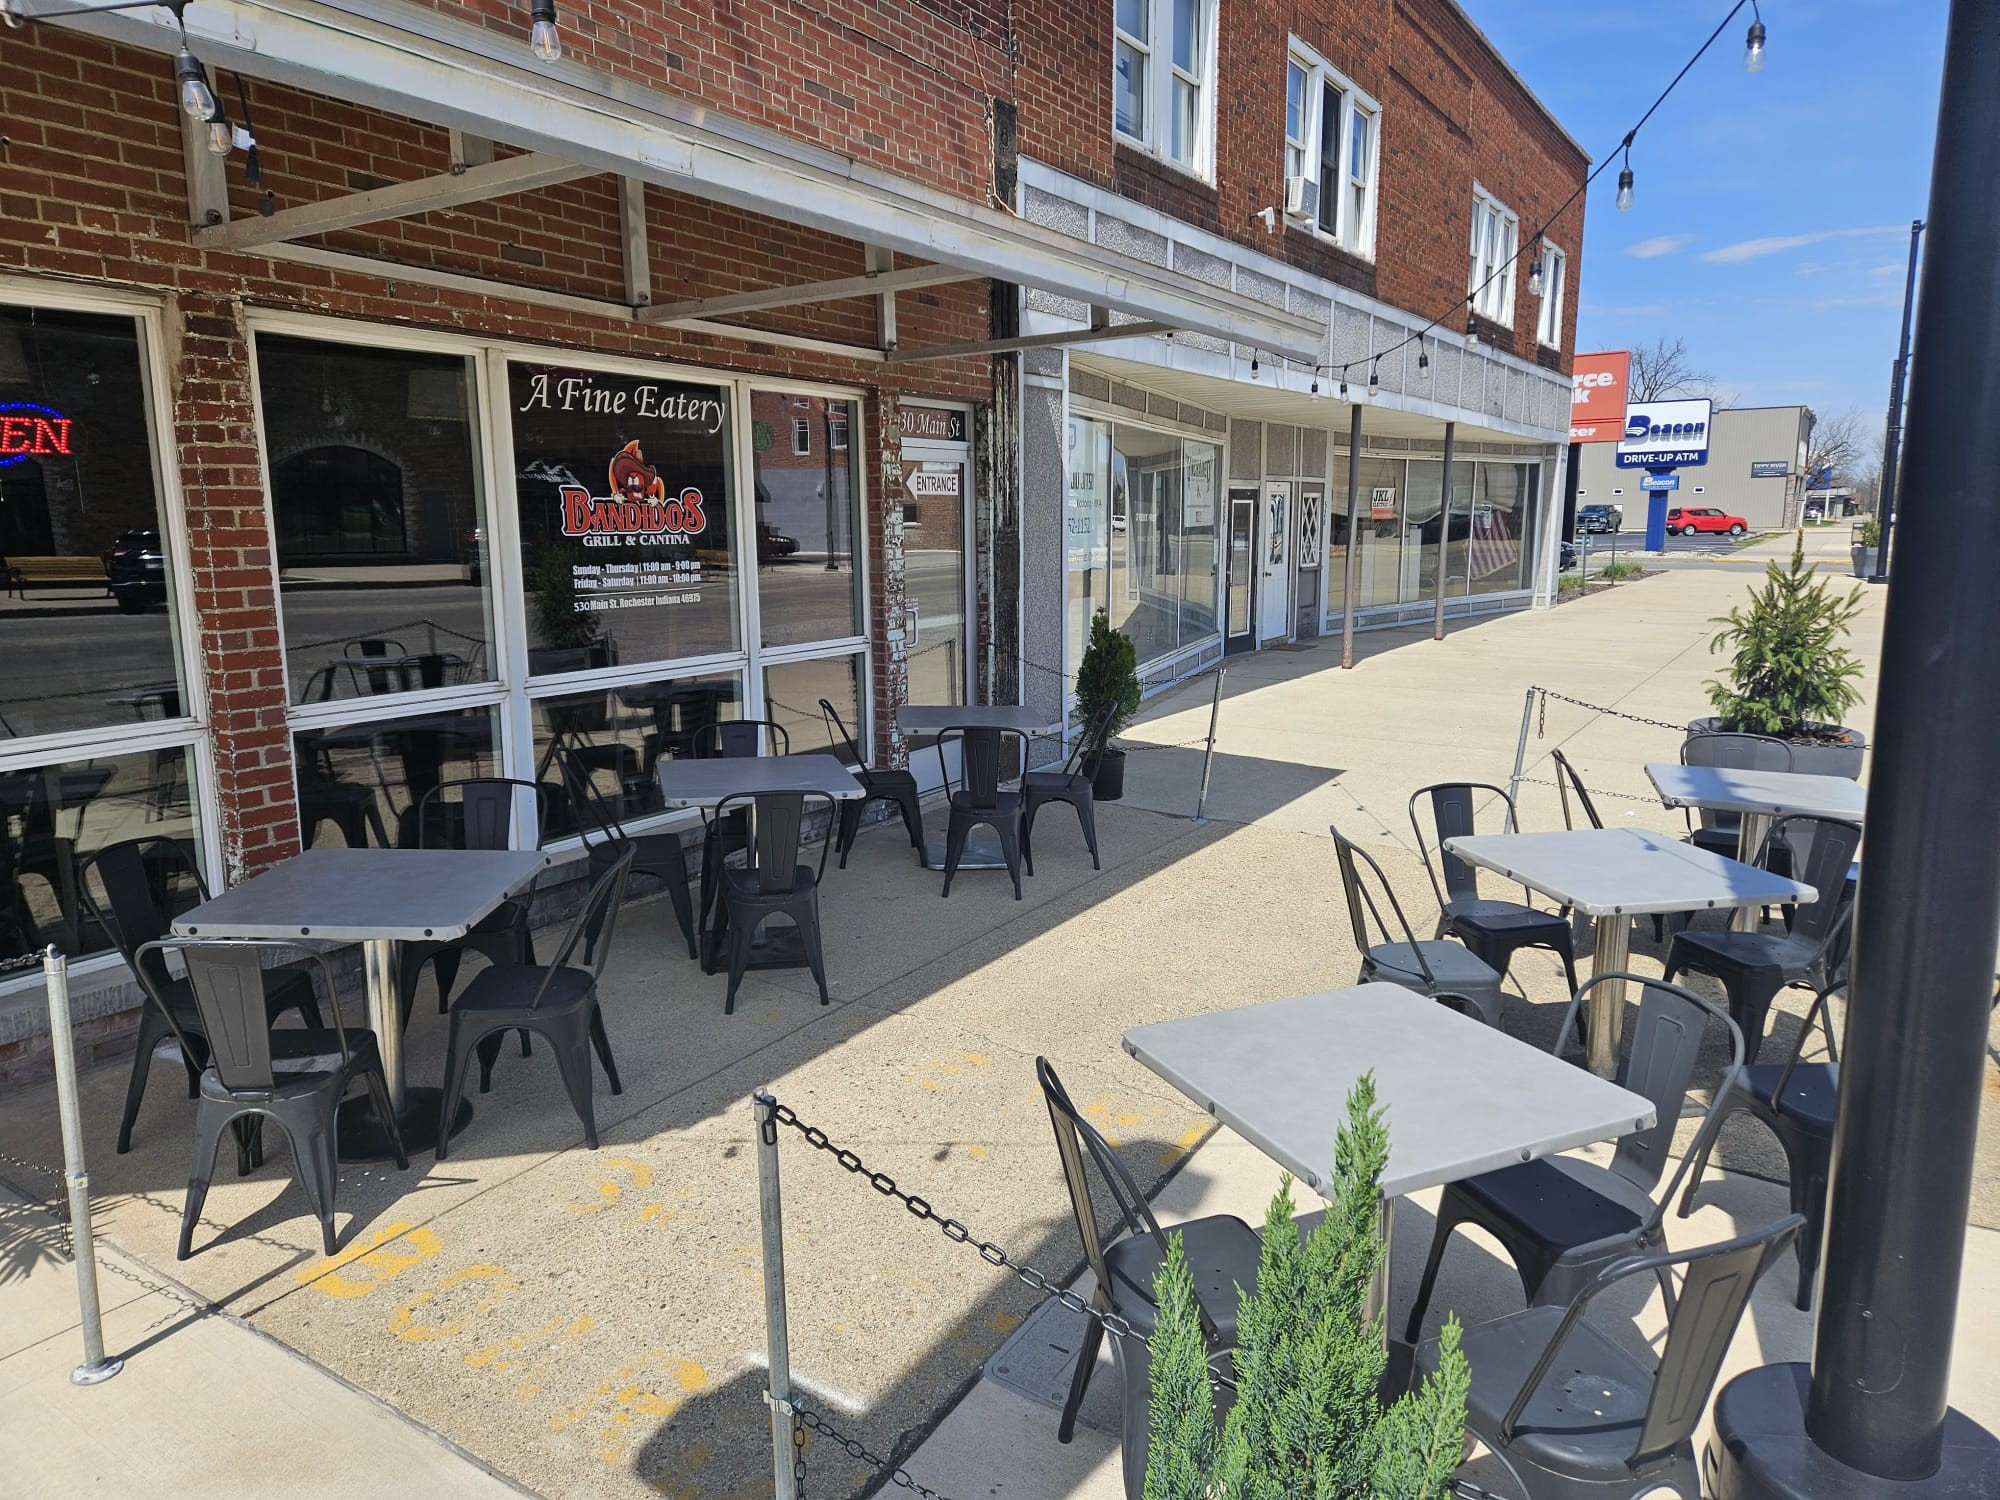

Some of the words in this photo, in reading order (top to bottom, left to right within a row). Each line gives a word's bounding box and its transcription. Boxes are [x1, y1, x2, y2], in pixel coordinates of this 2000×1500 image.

[520, 374, 551, 411] A
[557, 378, 626, 414] Fine
[634, 386, 726, 434] Eatery
[917, 413, 946, 436] Main
[948, 417, 960, 438] St
[1625, 415, 1706, 438] Beacon
[1624, 453, 1674, 463] DRIVE-UP
[1675, 452, 1698, 461] ATM
[916, 475, 957, 492] ENTRANCE
[1642, 476, 1675, 487] Beacon
[1373, 490, 1389, 501] JKL
[560, 486, 705, 535] BANDIDOS
[583, 535, 622, 547] GRILL
[625, 535, 636, 546] &
[639, 534, 690, 545] CANTINA
[573, 564, 600, 575] Sunday
[605, 563, 638, 574] Thursday
[643, 561, 659, 571] 11:00
[661, 562, 671, 571] am
[690, 561, 700, 571] pm
[574, 578, 597, 588] Friday
[602, 576, 634, 587] Saturday
[640, 575, 656, 584] 11:00
[658, 575, 668, 583] am
[690, 573, 700, 582] pm
[574, 602, 589, 612] 530
[590, 600, 609, 610] Main
[620, 596, 655, 608] Rochester
[655, 594, 680, 605] Indiana
